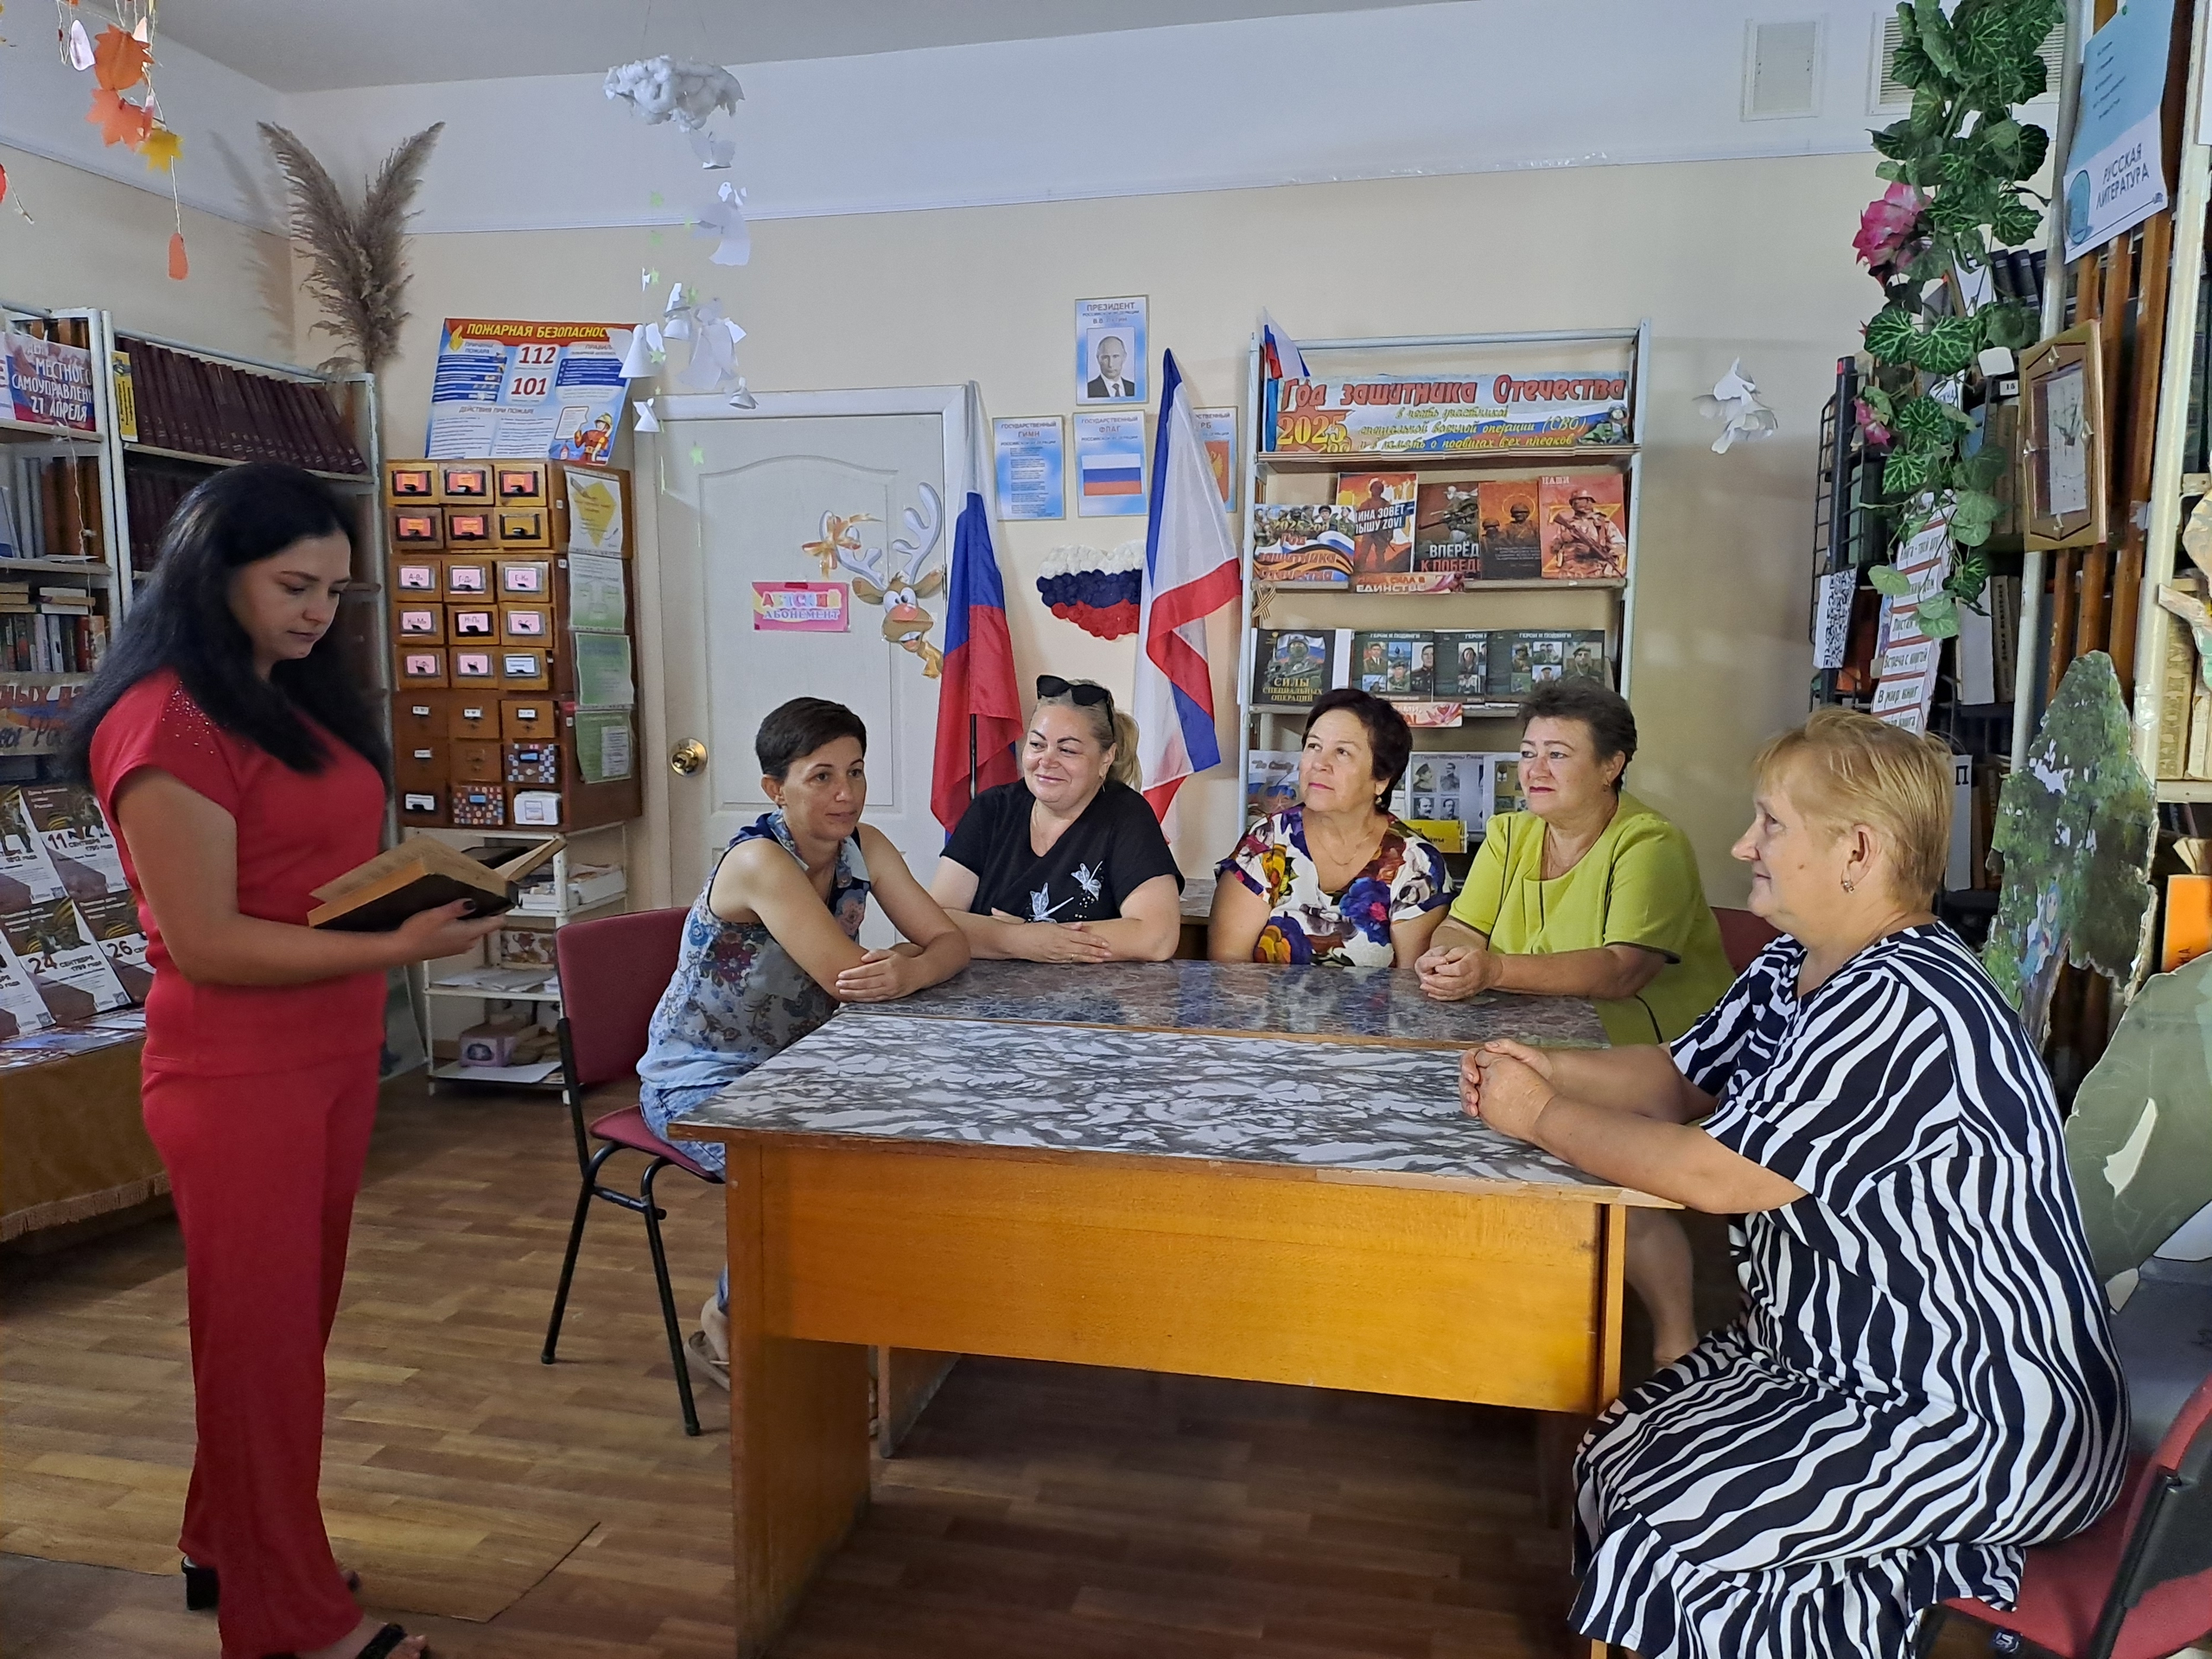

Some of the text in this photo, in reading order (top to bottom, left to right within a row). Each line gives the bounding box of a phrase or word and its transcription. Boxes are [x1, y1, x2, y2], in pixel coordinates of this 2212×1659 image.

[2102, 143, 2142, 185] РУССКАЯ
[2095, 162, 2149, 210] ЛИТЕРАТУРА
[1086, 302, 1135, 311] ПРЕЗИДЕНТ
[466, 323, 607, 339] ПОЖАРНАЯ БЕЗОПАСНОС
[518, 346, 556, 365] 112
[35, 356, 92, 385] МЕСТНОГО
[511, 378, 547, 396] 101
[1282, 374, 1626, 412] Год защитника Отечества
[30, 396, 88, 423] 21 АПРЕЛЯ
[1277, 415, 1347, 444] 2025
[1542, 416, 1587, 434] (СВО)
[1356, 521, 1382, 535] ЛЫШУ
[1429, 542, 1479, 558] ВПЕРЁД
[1421, 560, 1428, 572] К
[765, 609, 840, 620] АБОНЕМЕНТ
[1274, 677, 1309, 687] СИЛЫ
[1955, 765, 1969, 785] П
[48, 832, 67, 850] 11
[106, 940, 133, 958] 26
[28, 953, 58, 974] 24
